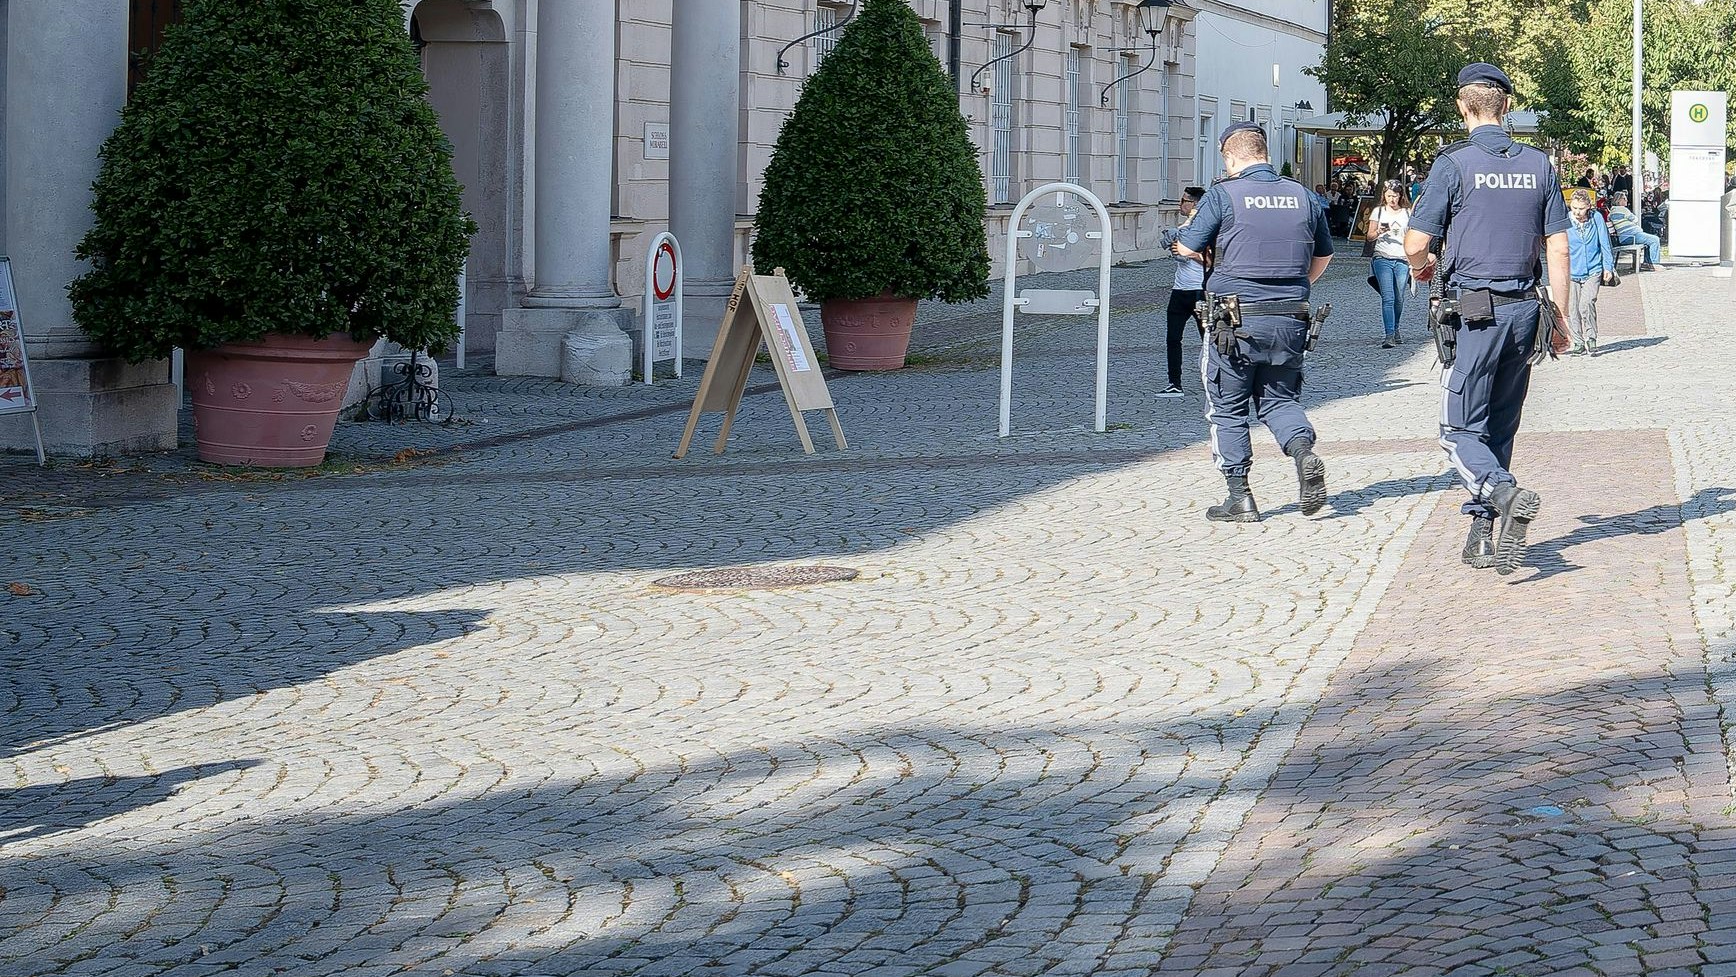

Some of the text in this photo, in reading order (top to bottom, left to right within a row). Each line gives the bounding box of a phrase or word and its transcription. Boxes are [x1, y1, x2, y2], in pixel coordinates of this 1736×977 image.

[1694, 108, 1703, 119] H
[1474, 172, 1537, 190] POLIZEI
[1244, 196, 1299, 210] POLIZEI
